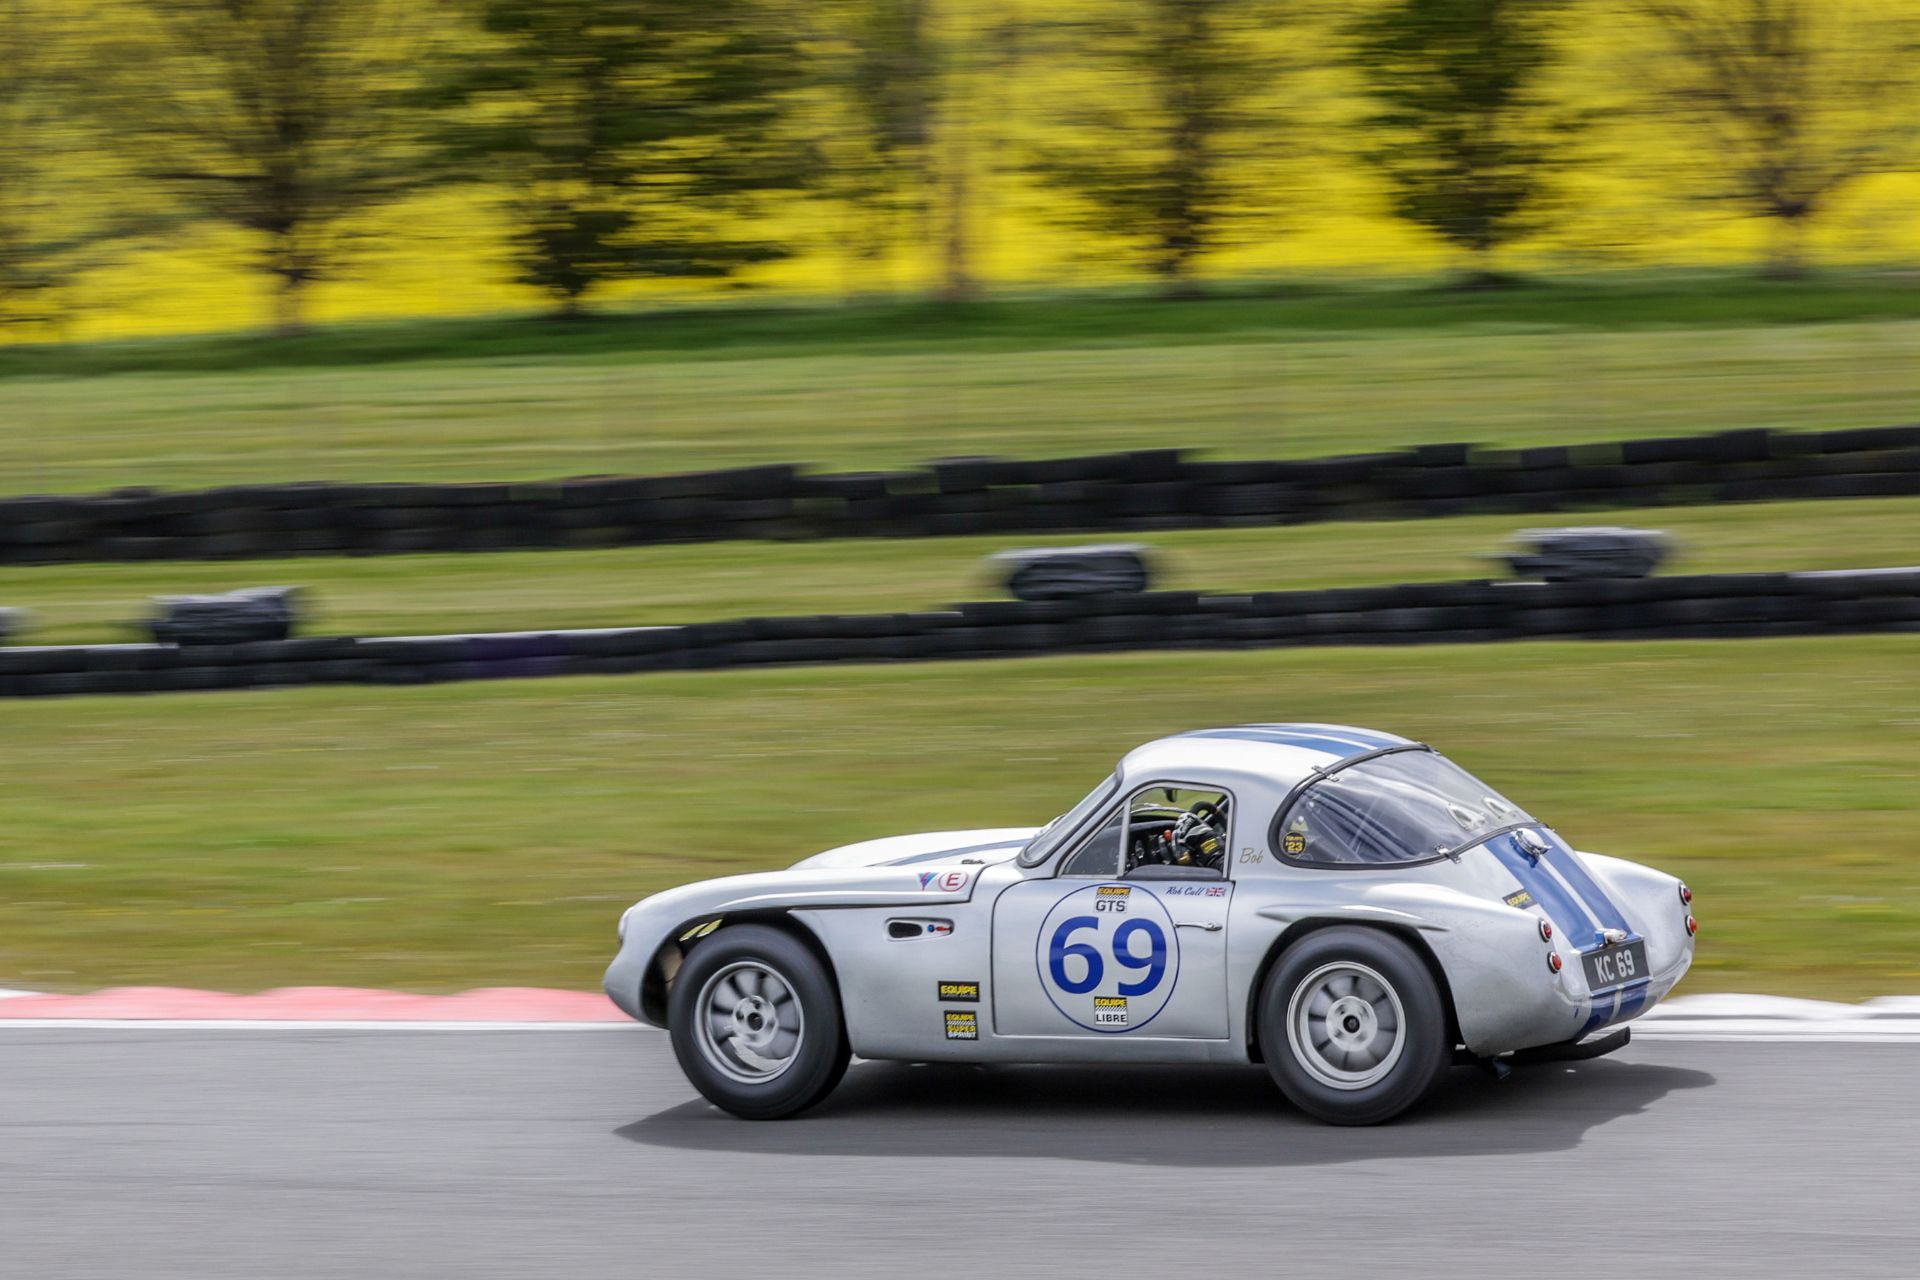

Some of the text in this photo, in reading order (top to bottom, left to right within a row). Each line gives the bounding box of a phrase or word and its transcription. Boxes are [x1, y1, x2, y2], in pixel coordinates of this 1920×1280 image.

[1240, 847, 1264, 864] Bob
[946, 873, 962, 886] E
[1097, 887, 1130, 895] EQUIPE
[1095, 900, 1126, 912] GTS
[1049, 915, 1167, 997] 69
[1594, 949, 1635, 984] KC 69
[941, 985, 977, 995] EQUIPE
[1095, 998, 1127, 1007] EQUIPE
[1096, 1014, 1127, 1022] LIBRE
